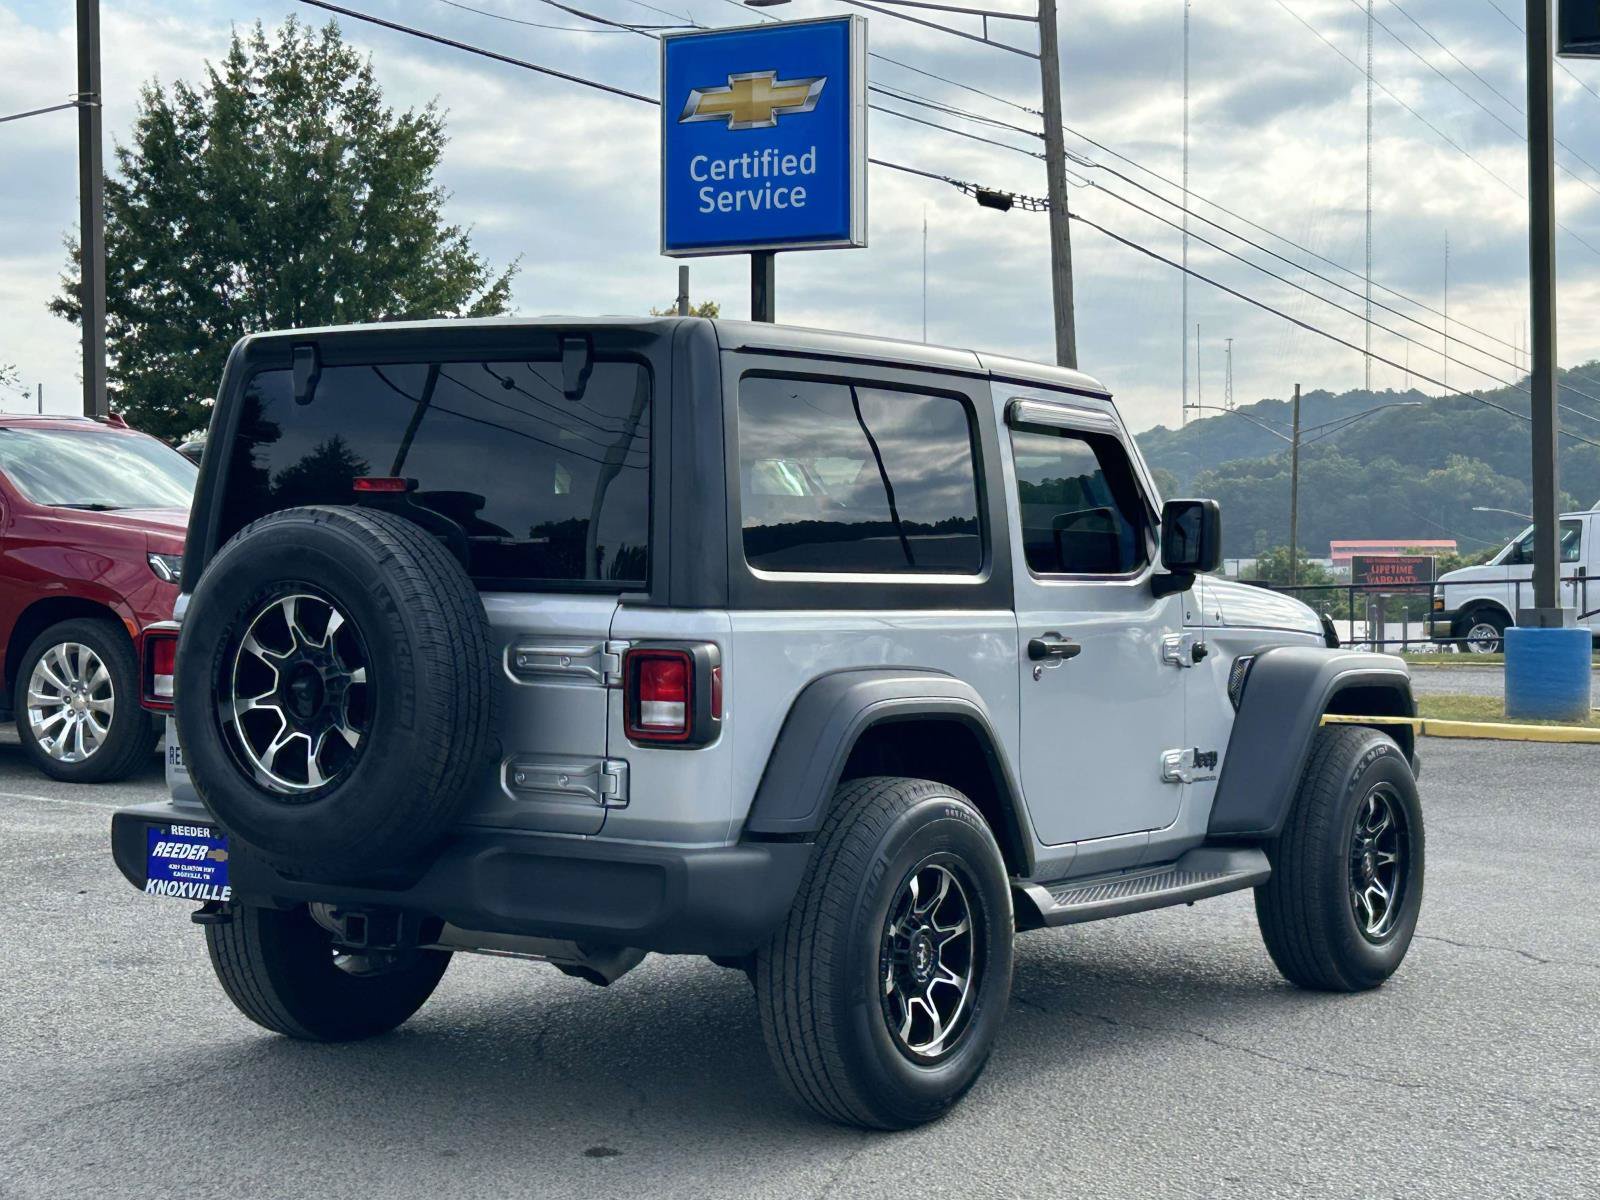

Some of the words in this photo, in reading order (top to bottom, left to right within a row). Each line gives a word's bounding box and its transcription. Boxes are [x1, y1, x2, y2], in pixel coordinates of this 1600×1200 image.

[690, 146, 816, 182] Certified
[699, 182, 807, 213] Service
[1371, 565, 1414, 575] LIFETIME
[171, 825, 210, 838] REEDER
[152, 841, 209, 860] REEDER
[145, 878, 232, 901] KNOXVILLE
